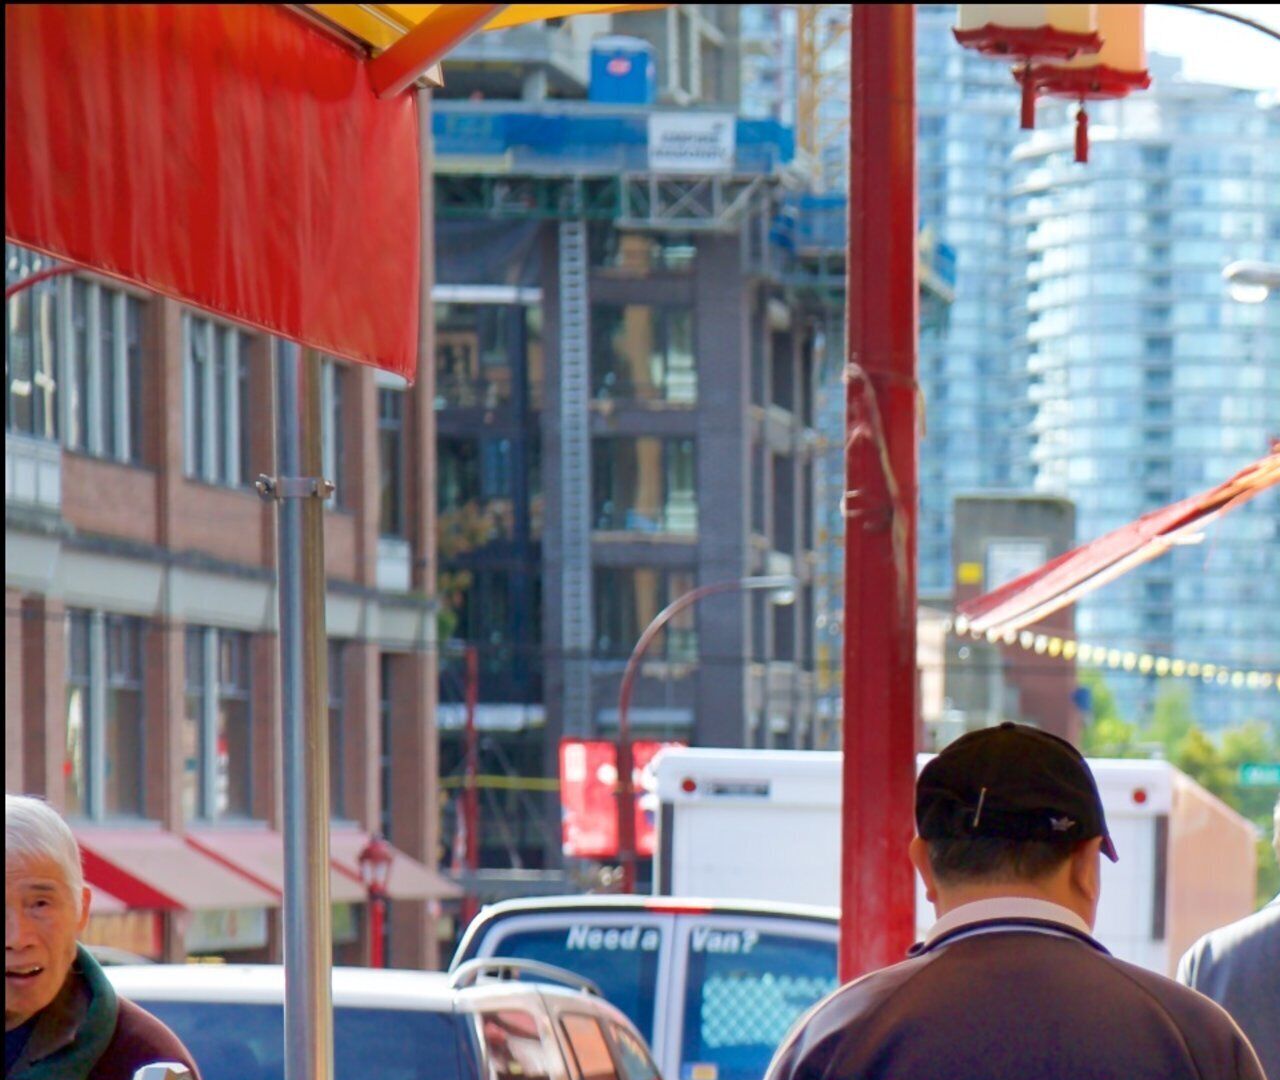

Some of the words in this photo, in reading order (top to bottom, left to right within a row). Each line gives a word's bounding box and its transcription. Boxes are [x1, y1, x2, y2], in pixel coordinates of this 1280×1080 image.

[566, 923, 640, 951] Need
[641, 928, 660, 951] a
[690, 926, 760, 953] Van?
